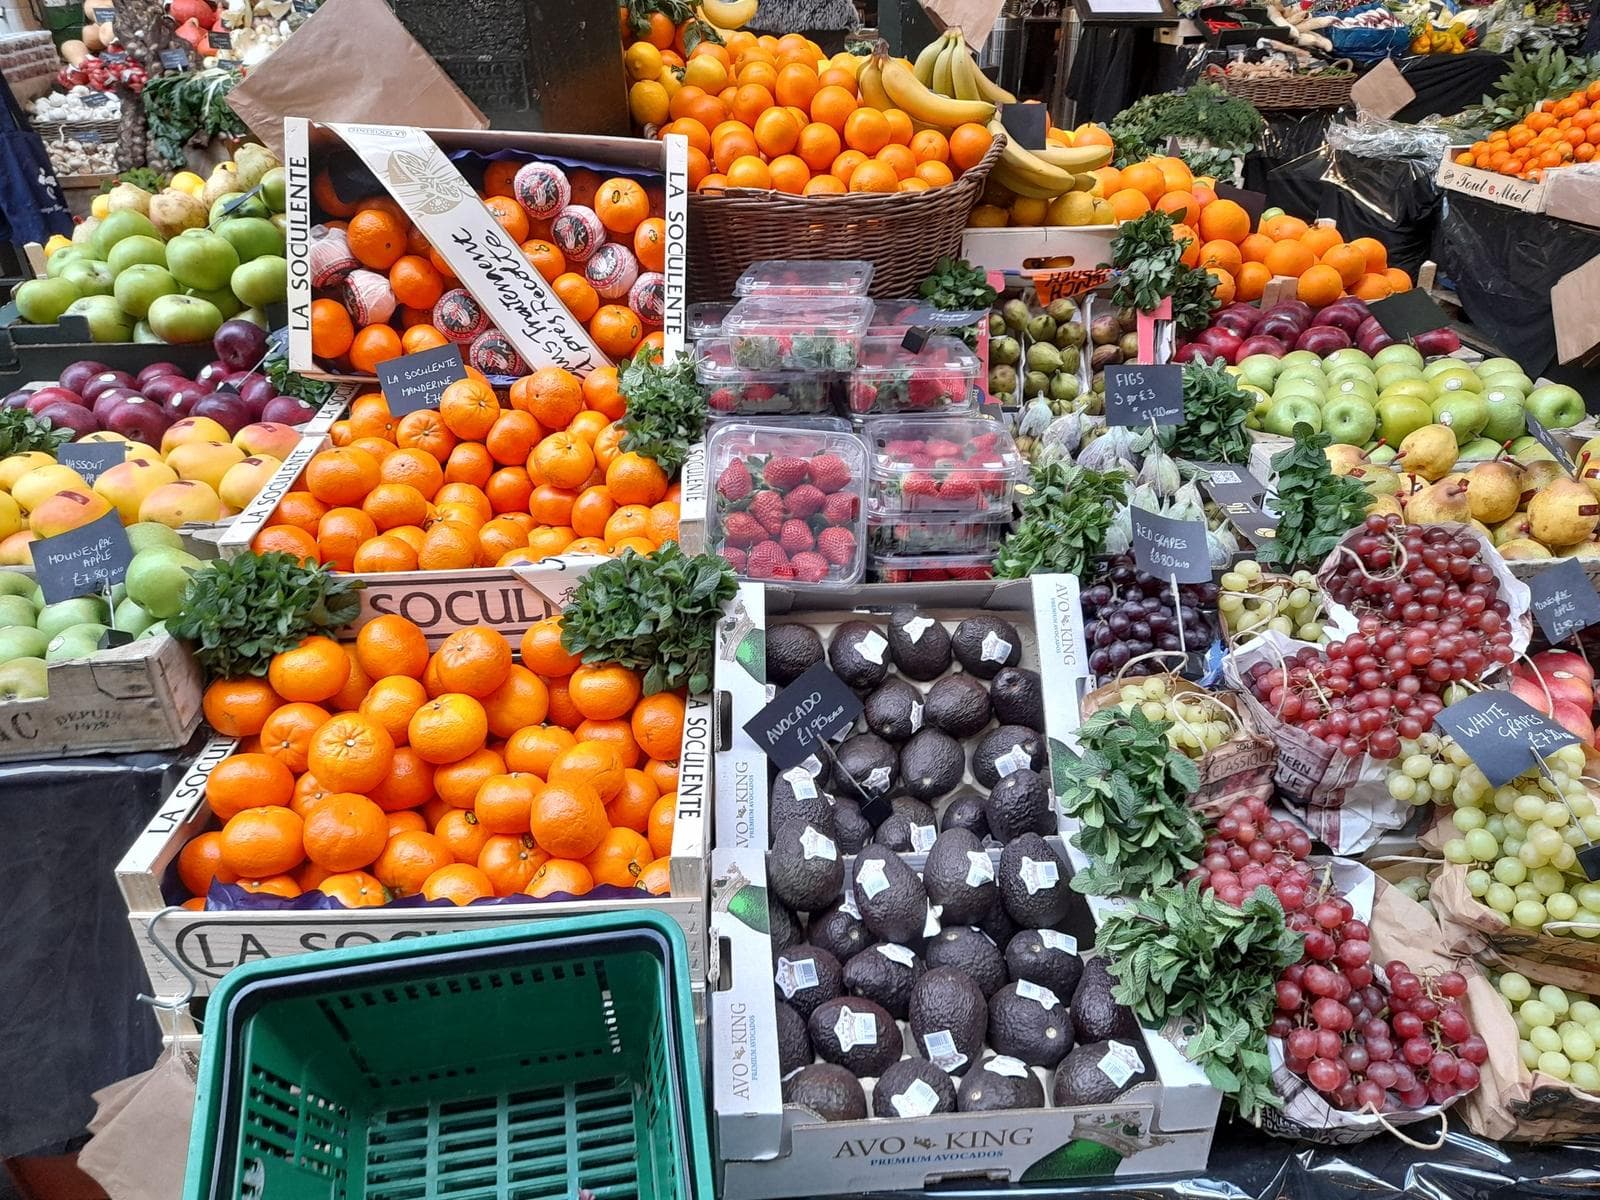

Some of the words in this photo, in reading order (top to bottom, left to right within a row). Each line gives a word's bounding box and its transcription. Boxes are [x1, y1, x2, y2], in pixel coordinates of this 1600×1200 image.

[668, 172, 688, 199] LA
[289, 156, 309, 291] SOCULENTE
[666, 211, 687, 335] SOCULENTE
[292, 304, 310, 331] LA
[387, 375, 399, 384] LA
[404, 358, 457, 380] SOCULENTE
[1115, 372, 1145, 387] FIGS
[1113, 392, 1124, 405] 3
[1139, 388, 1156, 401] £3
[316, 409, 338, 420] LA
[242, 510, 269, 524] LA
[257, 449, 313, 505] SOCULENTE
[1135, 522, 1153, 541] RED
[1154, 533, 1188, 549] GRAPES
[83, 550, 112, 568] APPLE
[369, 588, 553, 628] SOCUL
[1056, 583, 1070, 612] AVO
[1061, 628, 1076, 666] KING
[766, 691, 822, 745] AVOCADO
[1456, 702, 1509, 738] WHITE
[1498, 714, 1543, 739] GRAPES
[678, 717, 708, 820] SOCULENTE
[736, 761, 748, 803] KING
[147, 808, 186, 834] LA
[194, 933, 272, 968] LA
[730, 1003, 747, 1044] KING
[732, 1063, 749, 1101] AVO
[832, 1136, 906, 1159] AVO
[945, 1127, 1034, 1150] KING
[870, 1154, 931, 1167] PREMIUM
[934, 1150, 1004, 1162] AVOCADOS
